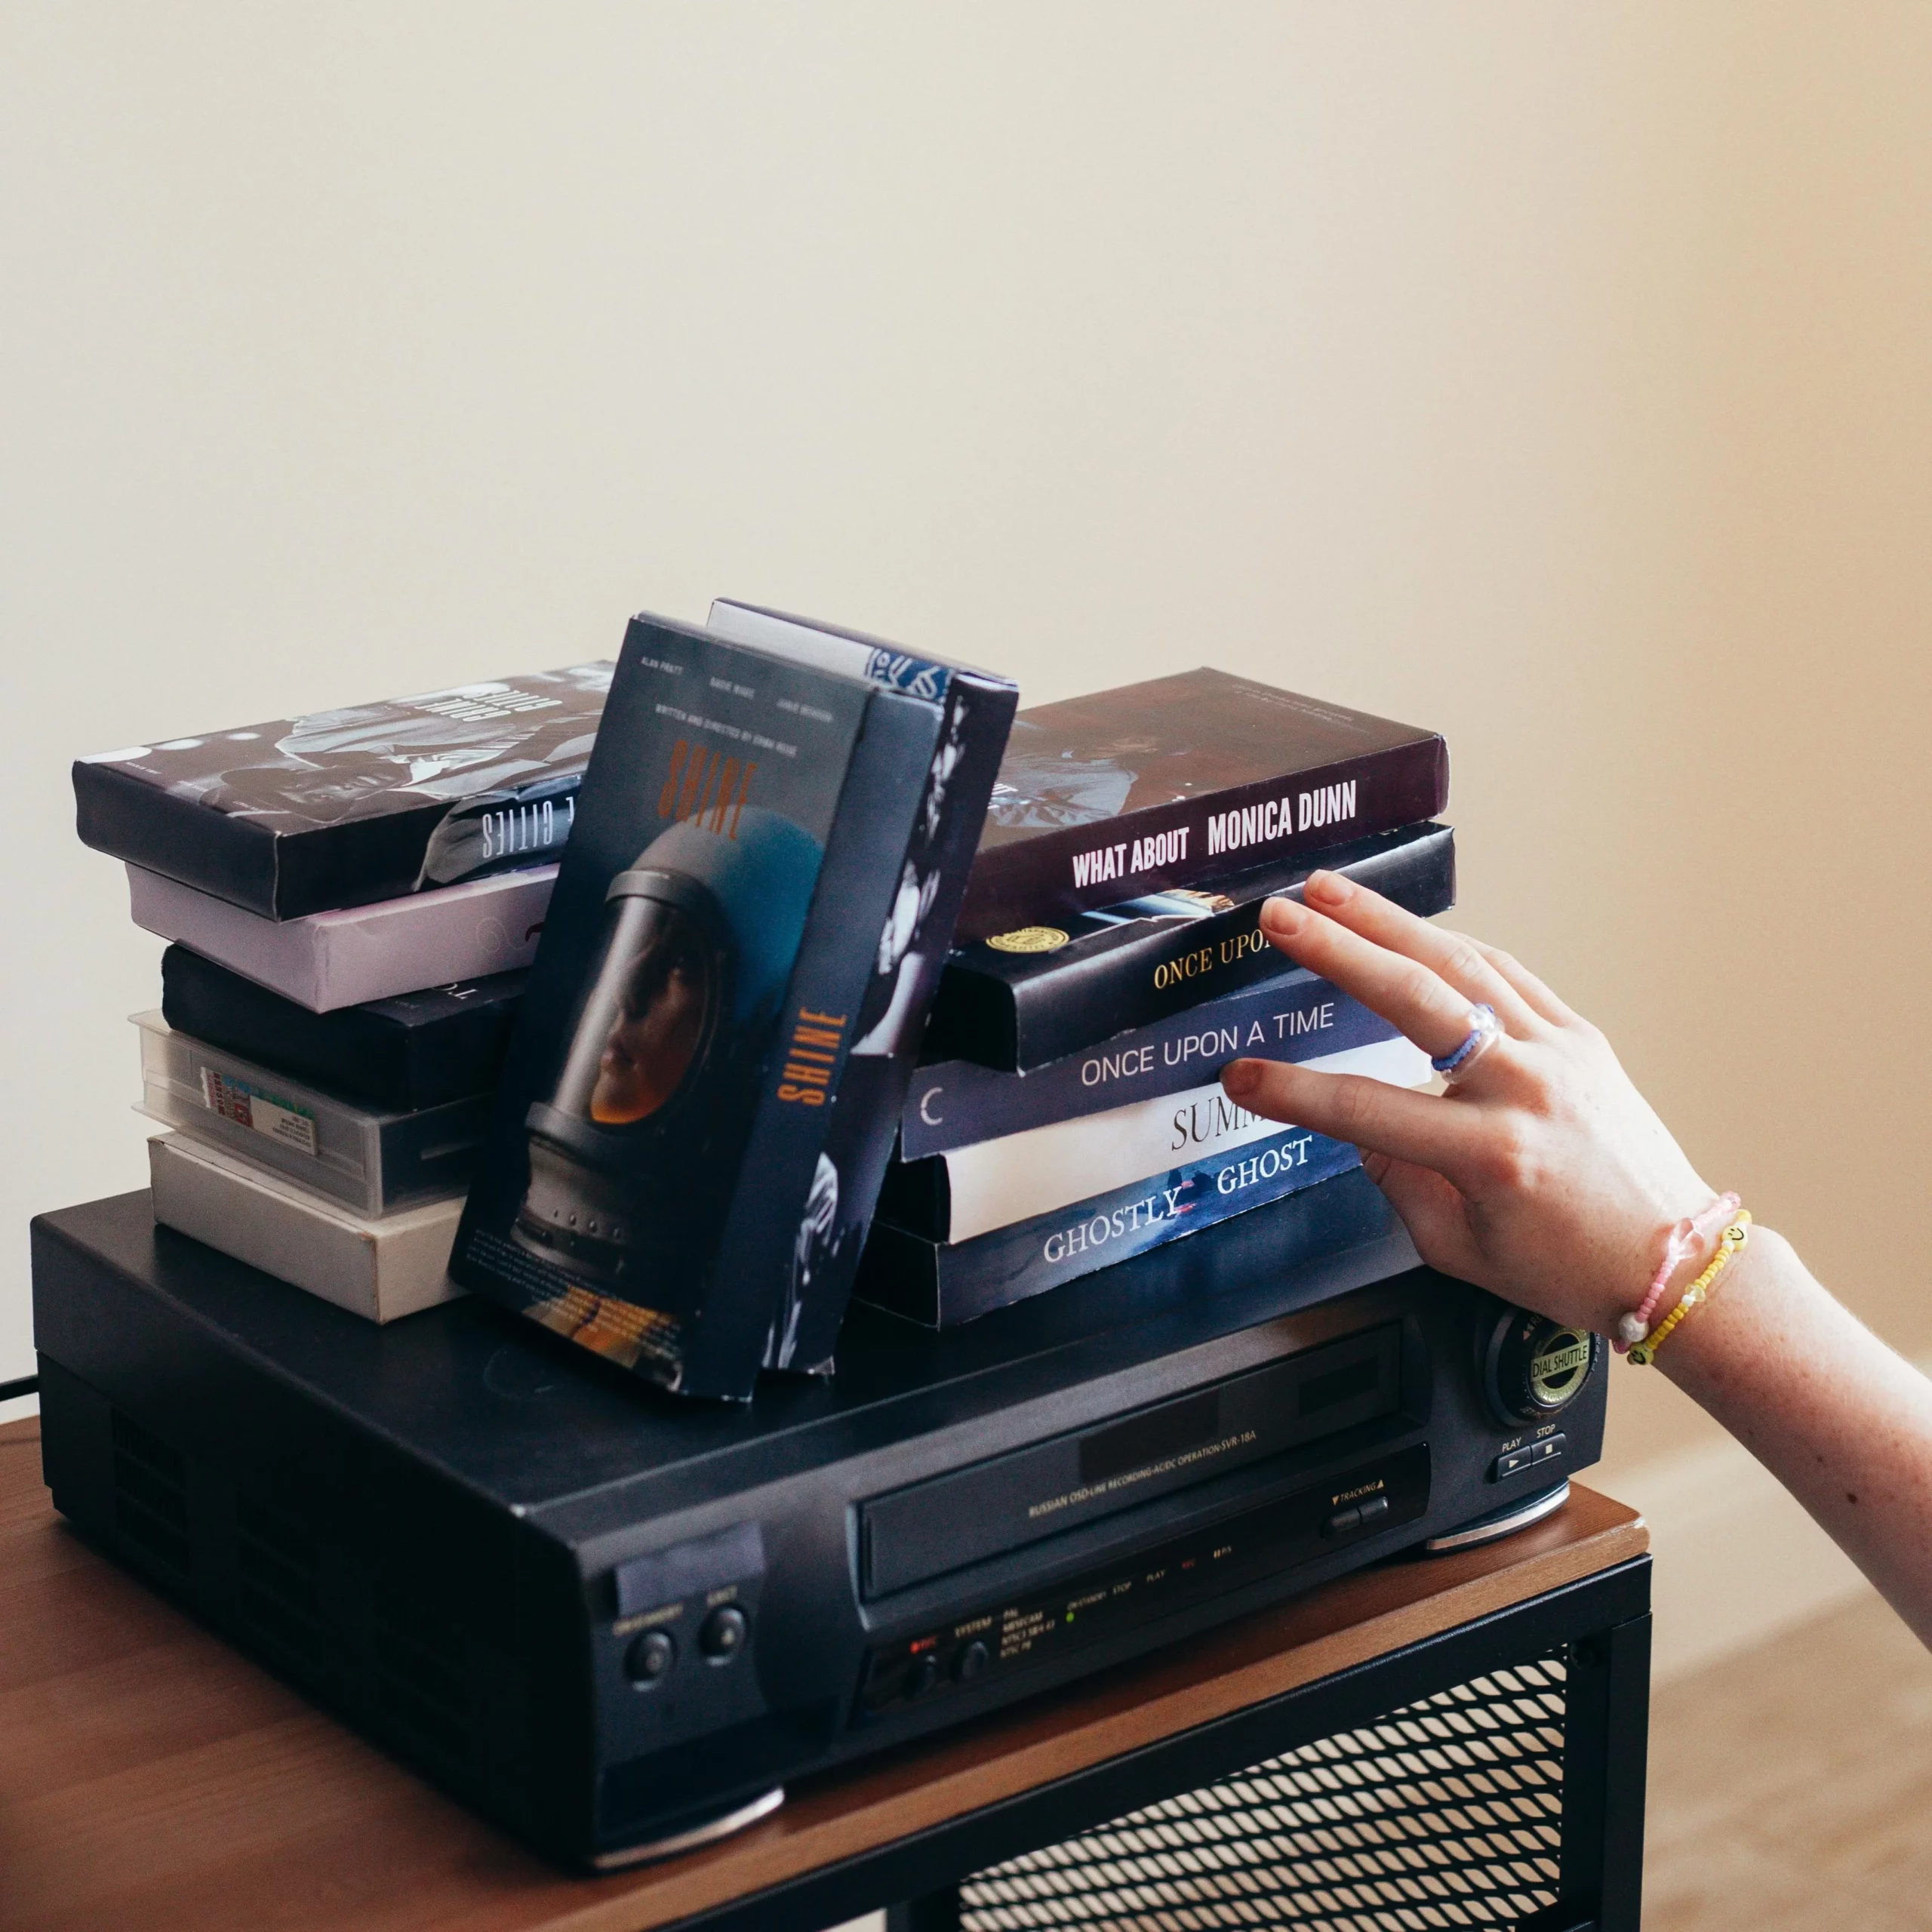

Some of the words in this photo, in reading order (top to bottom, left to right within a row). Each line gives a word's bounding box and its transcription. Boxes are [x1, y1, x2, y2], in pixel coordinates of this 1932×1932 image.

[658, 740, 758, 840] SHINE
[483, 801, 552, 858] CITIES
[1072, 843, 1128, 888] WHAT
[1131, 826, 1189, 873] ABOUT
[1208, 797, 1292, 855] MONICA
[1298, 780, 1356, 832] DUNN
[1154, 947, 1212, 989] ONCE
[1220, 929, 1271, 964] UPO
[777, 1006, 848, 1106] SHINE
[1081, 1045, 1155, 1086] ONCE
[1164, 1026, 1238, 1066] UPON
[1246, 1020, 1265, 1047] A
[1273, 1002, 1334, 1038] TIME
[1044, 1186, 1183, 1263] GHOSTLY
[1217, 1135, 1313, 1195] GHOST
[1533, 1362, 1552, 1377] DIAL
[1554, 1345, 1588, 1371] SHUTTLE
[1502, 1437, 1522, 1452] PLAY
[1537, 1424, 1555, 1438] STOP
[1340, 1481, 1377, 1502] TRACKING
